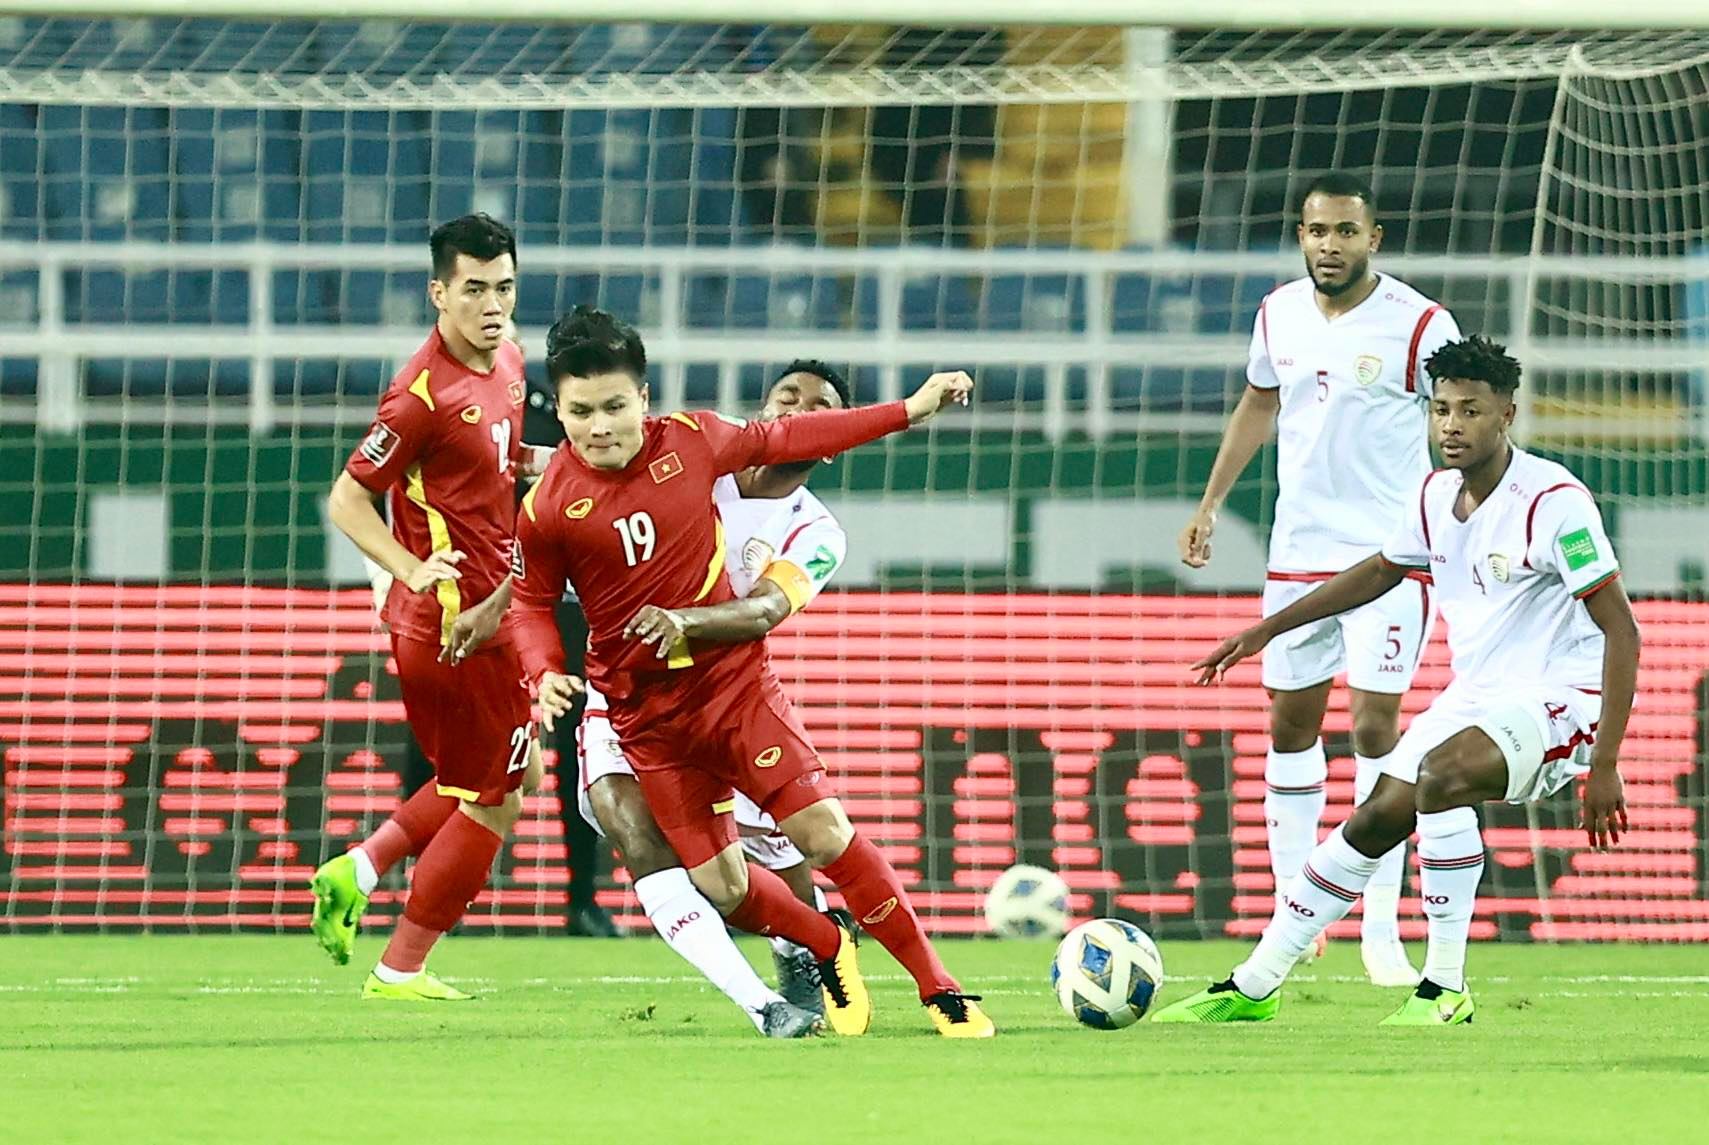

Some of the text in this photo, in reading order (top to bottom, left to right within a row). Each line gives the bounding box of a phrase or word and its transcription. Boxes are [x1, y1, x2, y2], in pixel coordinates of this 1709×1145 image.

[1316, 370, 1329, 403] 5
[612, 510, 656, 567] 19
[1472, 563, 1487, 596] 4
[1383, 625, 1401, 661] 5
[1377, 663, 1405, 673] JAKO
[775, 839, 791, 851] JA
[666, 911, 700, 941] JAKO
